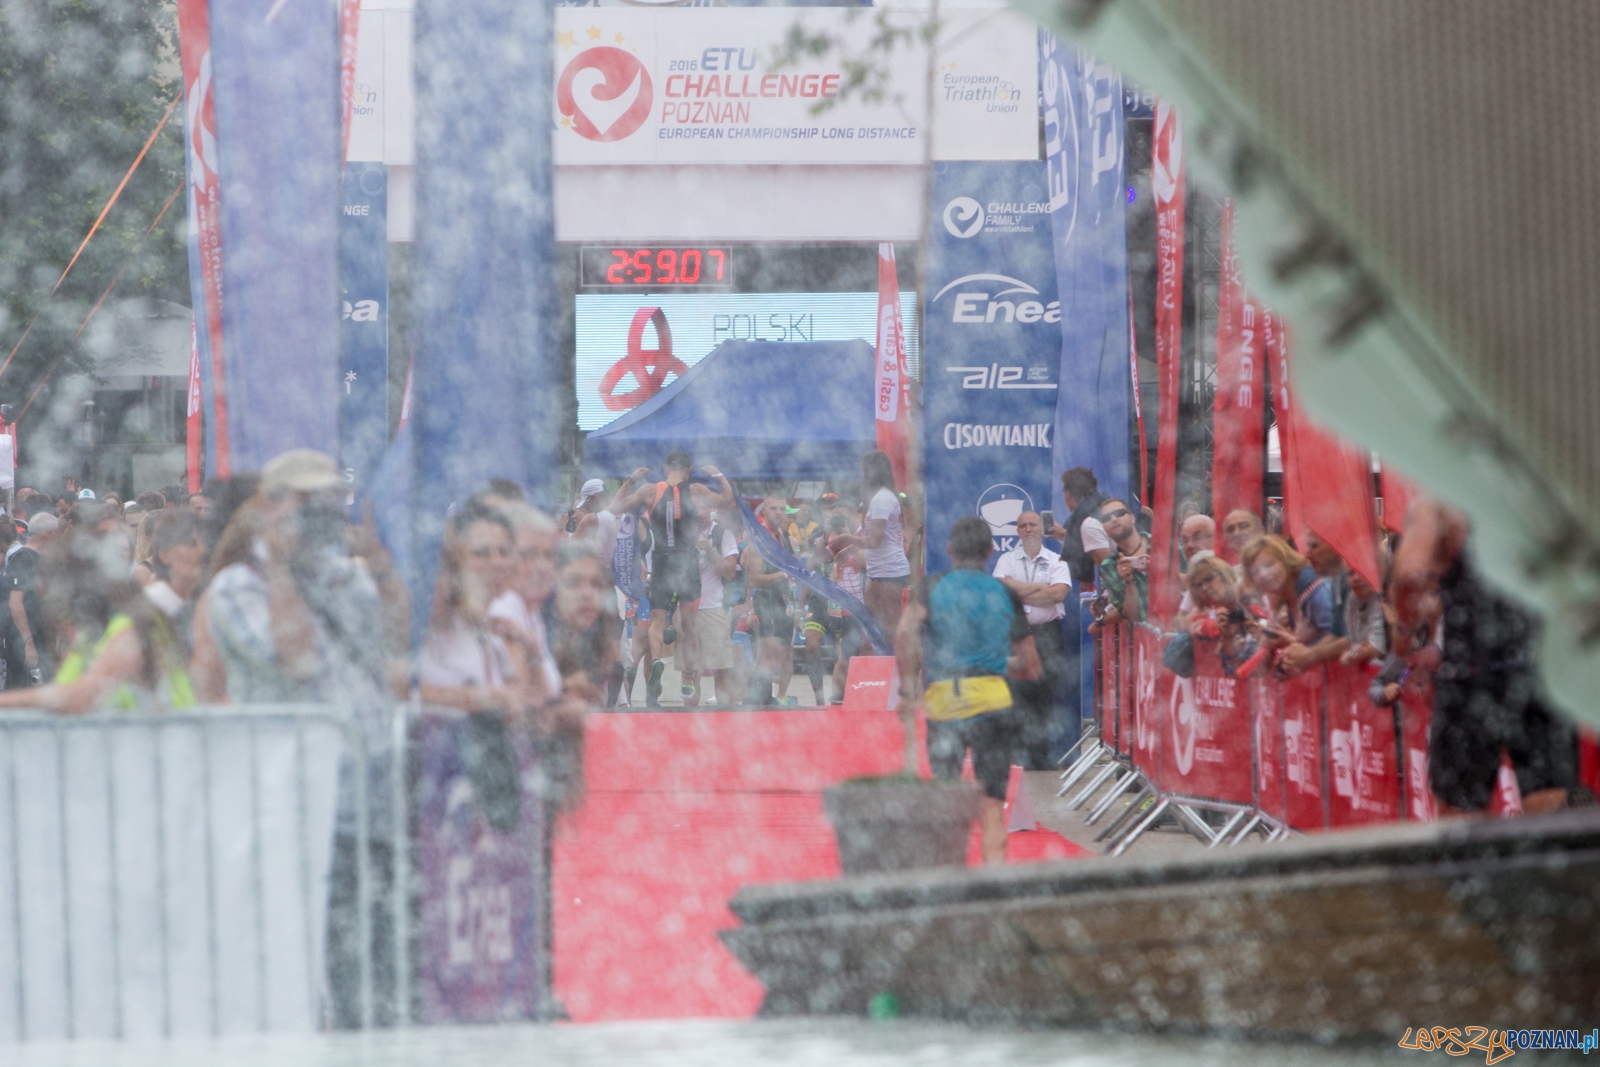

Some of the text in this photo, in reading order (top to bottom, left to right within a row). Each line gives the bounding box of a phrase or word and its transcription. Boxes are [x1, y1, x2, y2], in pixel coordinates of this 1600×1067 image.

[669, 47, 757, 71] 2016 ETU
[664, 74, 841, 98] CHALLENGE
[943, 73, 1000, 86] European
[943, 85, 1021, 101] Triathlon
[661, 101, 751, 124] POZNAN
[986, 102, 1018, 113] Union
[658, 127, 916, 139] EUROPEAN CHAMPIONSHIP LONG DISTANCE
[987, 202, 1053, 214] CHALLENG
[985, 214, 1022, 226] FAMILY
[952, 293, 1062, 323] Enea
[713, 313, 814, 342] POLSKI
[943, 422, 1053, 450] CISOWIANK
